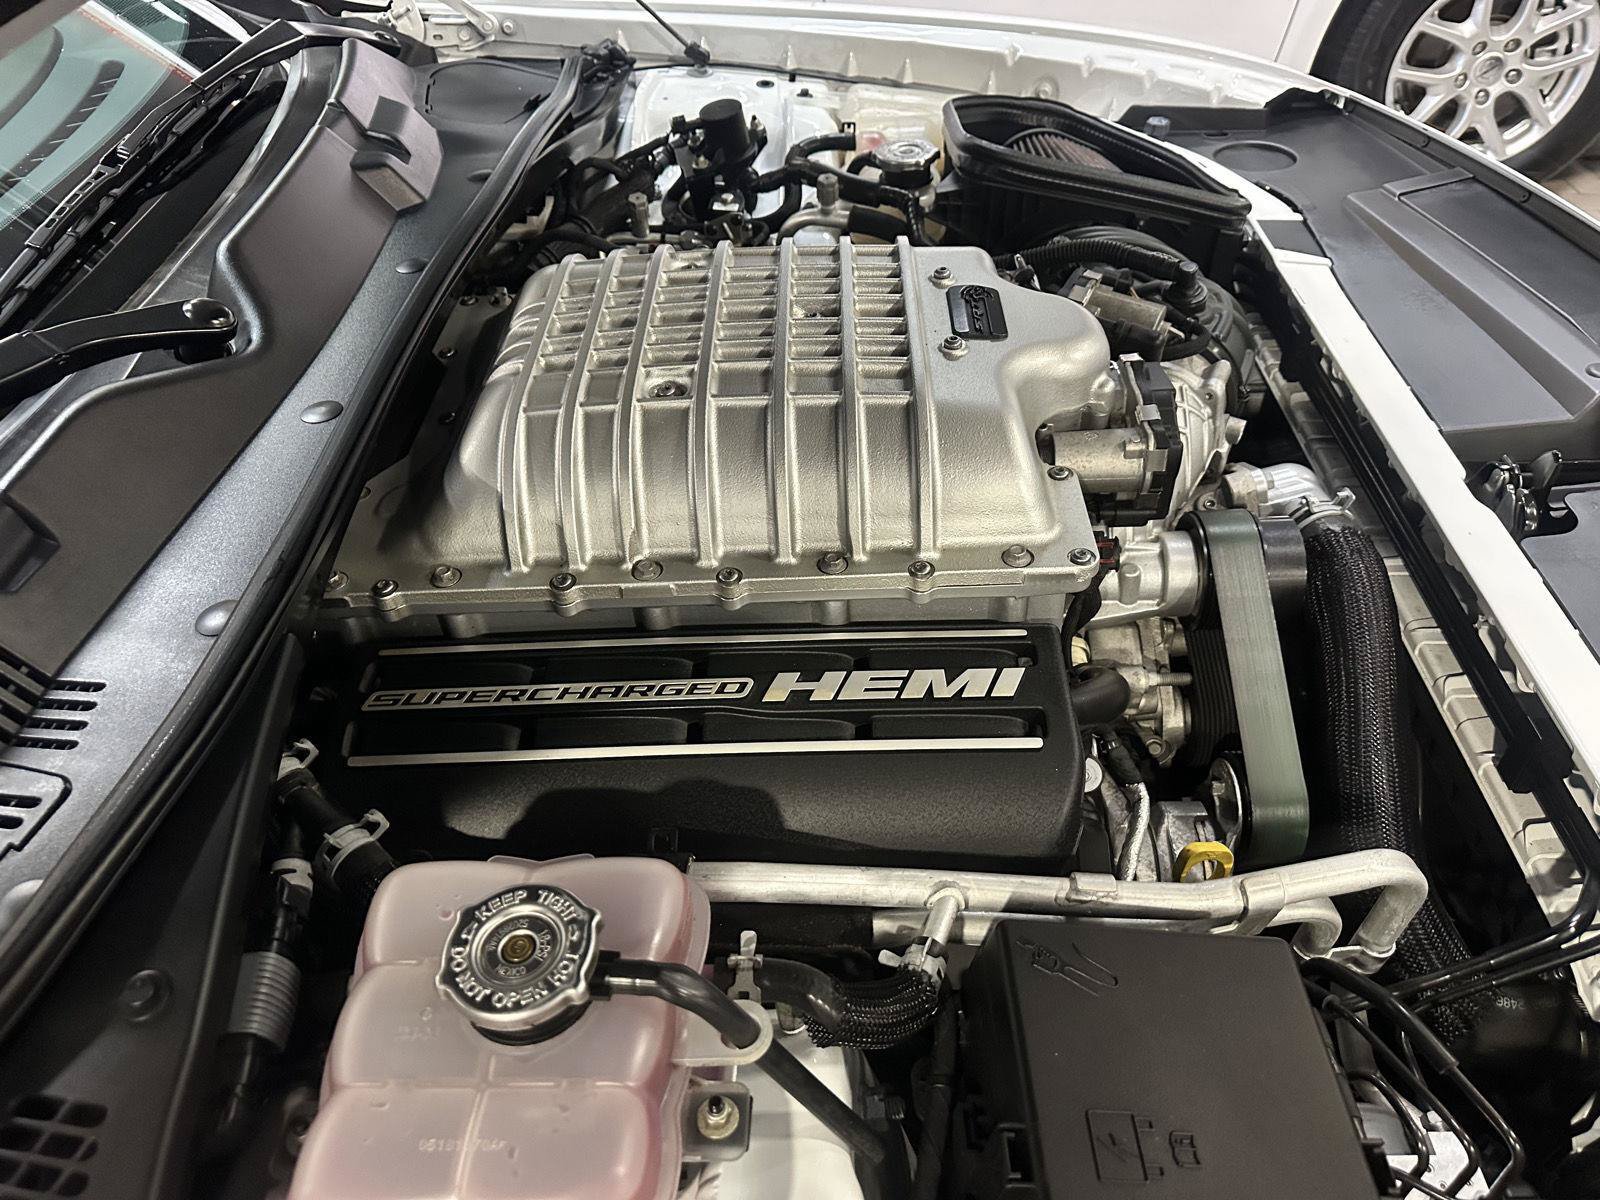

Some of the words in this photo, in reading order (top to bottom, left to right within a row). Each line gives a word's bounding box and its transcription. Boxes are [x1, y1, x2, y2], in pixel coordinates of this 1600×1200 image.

[365, 680, 749, 708] SUPERCHARGED
[762, 667, 1026, 702] HEMI
[474, 889, 528, 921] KEEP
[538, 889, 578, 921] TIGHT
[450, 946, 470, 972] DO
[548, 953, 579, 986] HOT
[455, 972, 492, 1001] NOT
[491, 981, 549, 1008] OPEN
